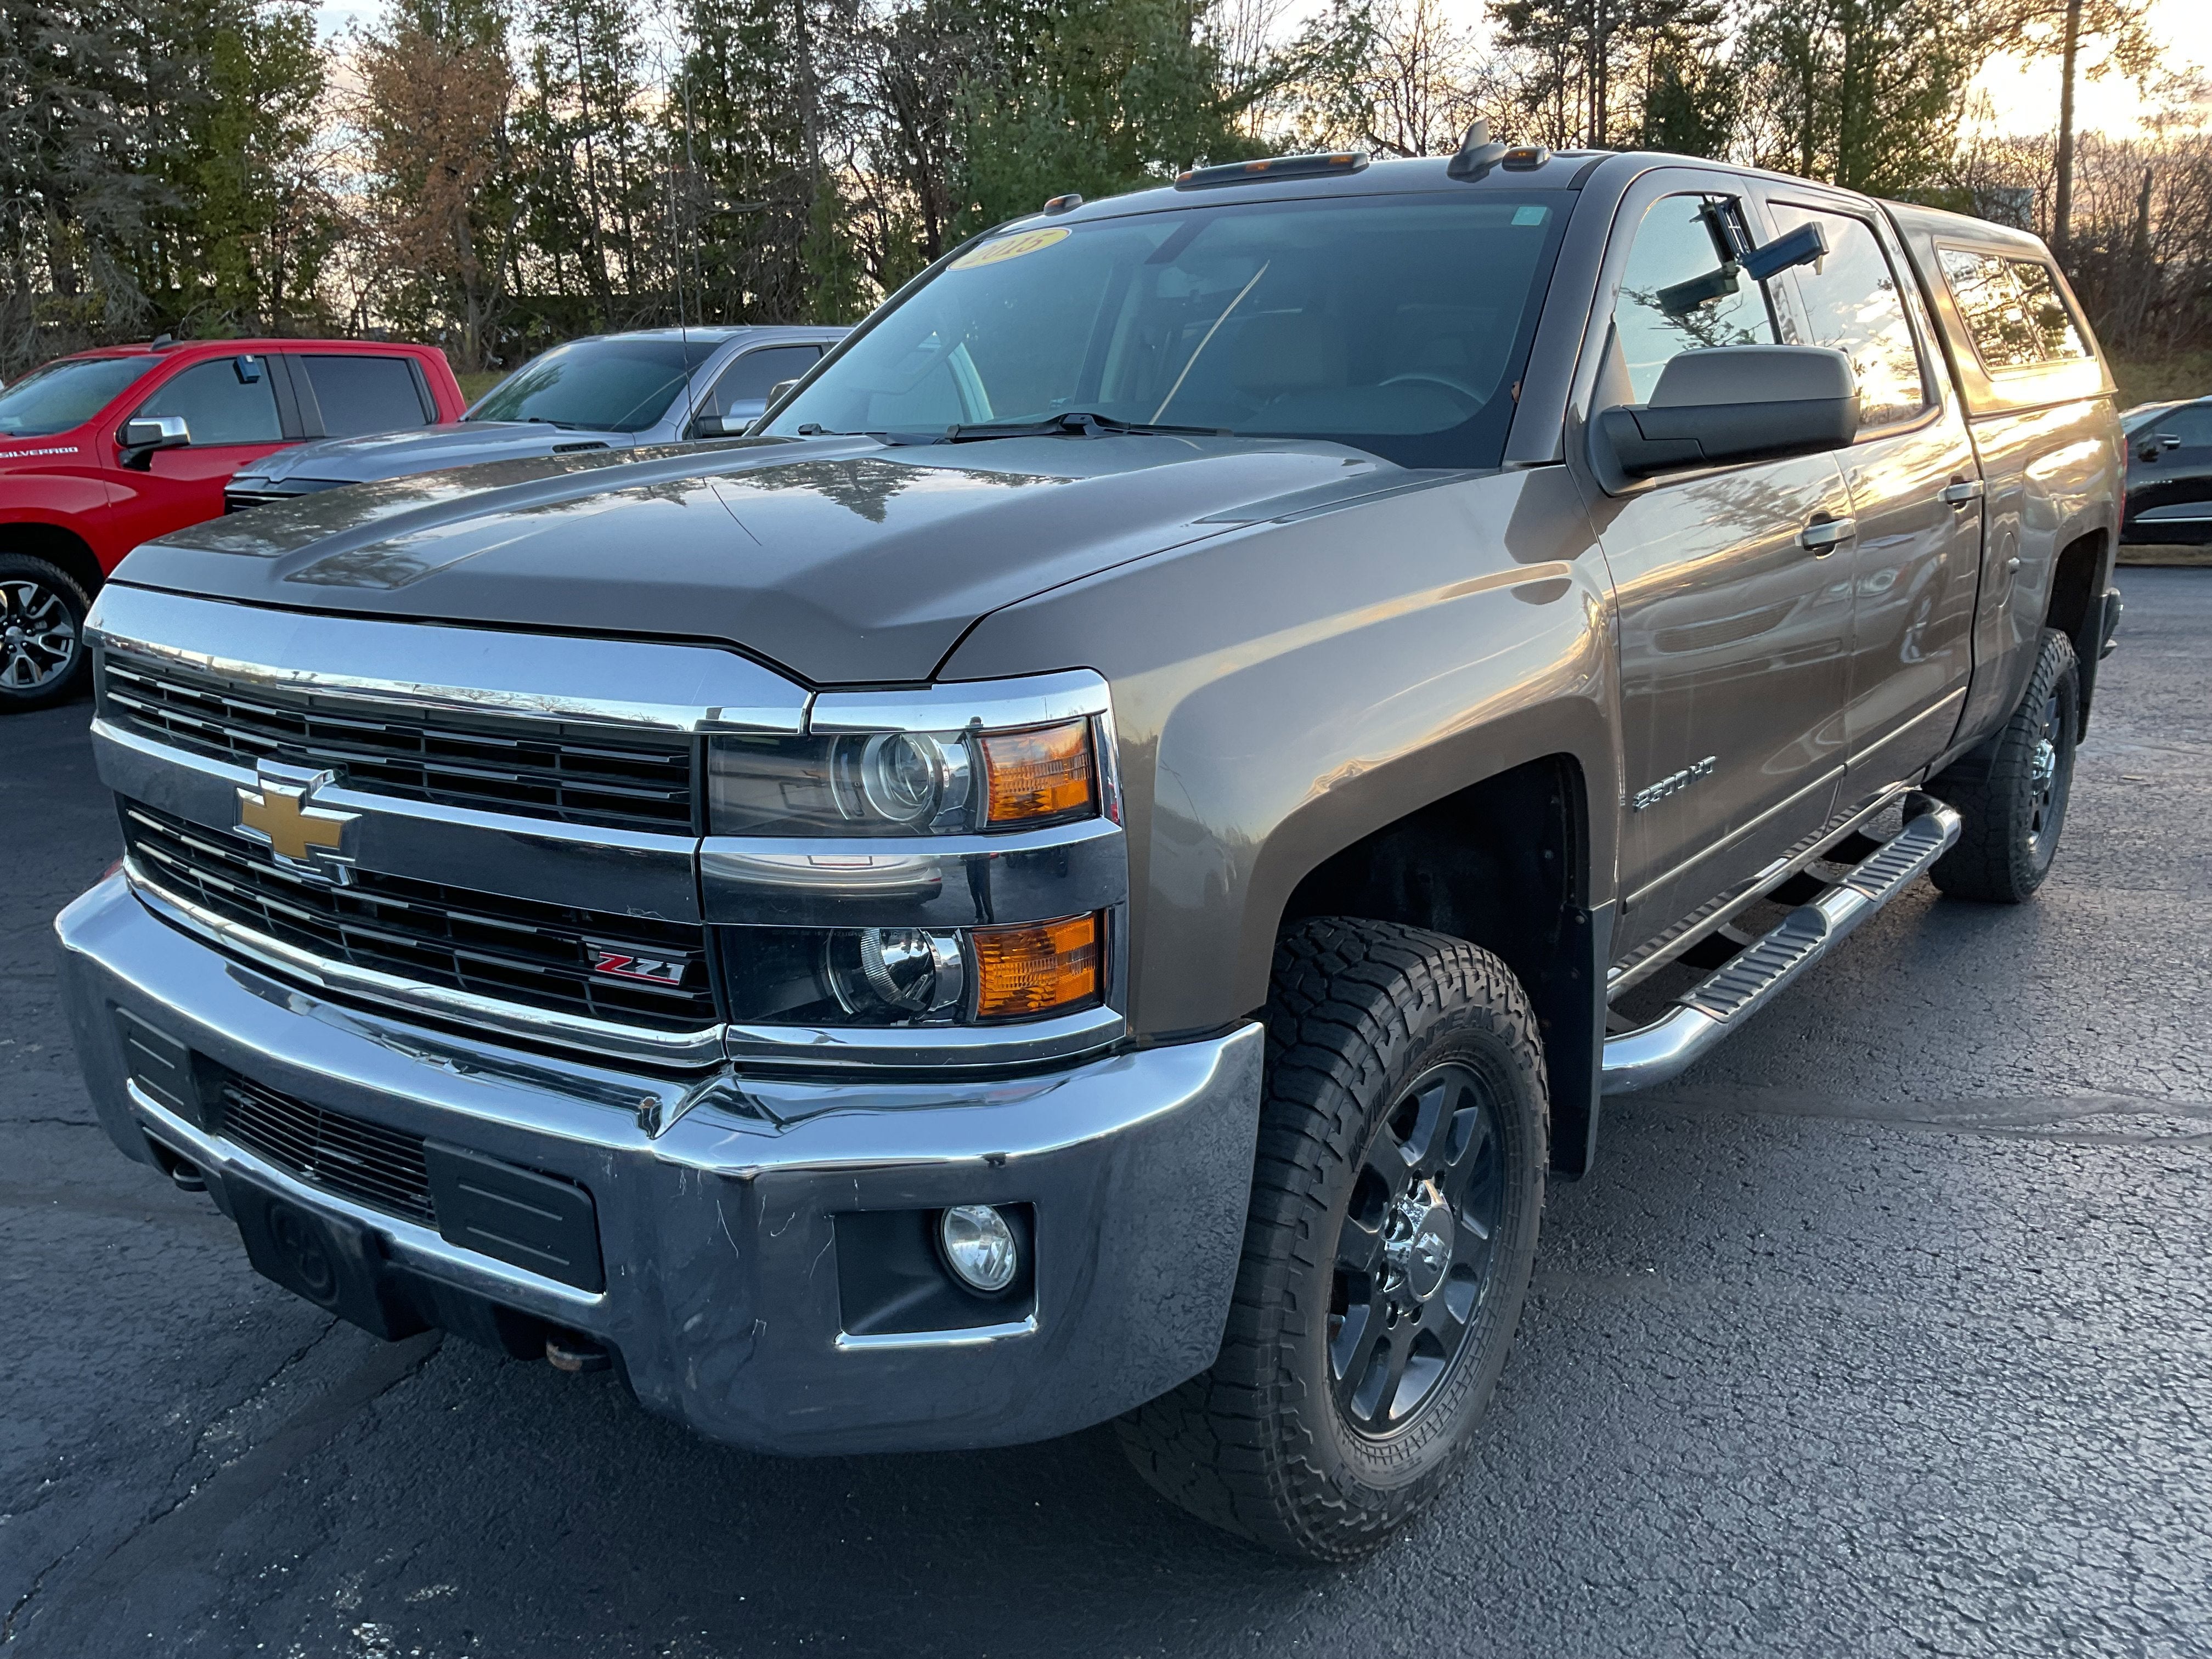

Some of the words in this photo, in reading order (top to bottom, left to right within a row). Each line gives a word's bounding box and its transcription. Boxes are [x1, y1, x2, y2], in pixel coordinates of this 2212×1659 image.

[959, 232, 1057, 267] 2015
[0, 446, 78, 458] SILVERADO
[1632, 755, 1716, 810] 2500HD
[595, 952, 685, 985] Z71
